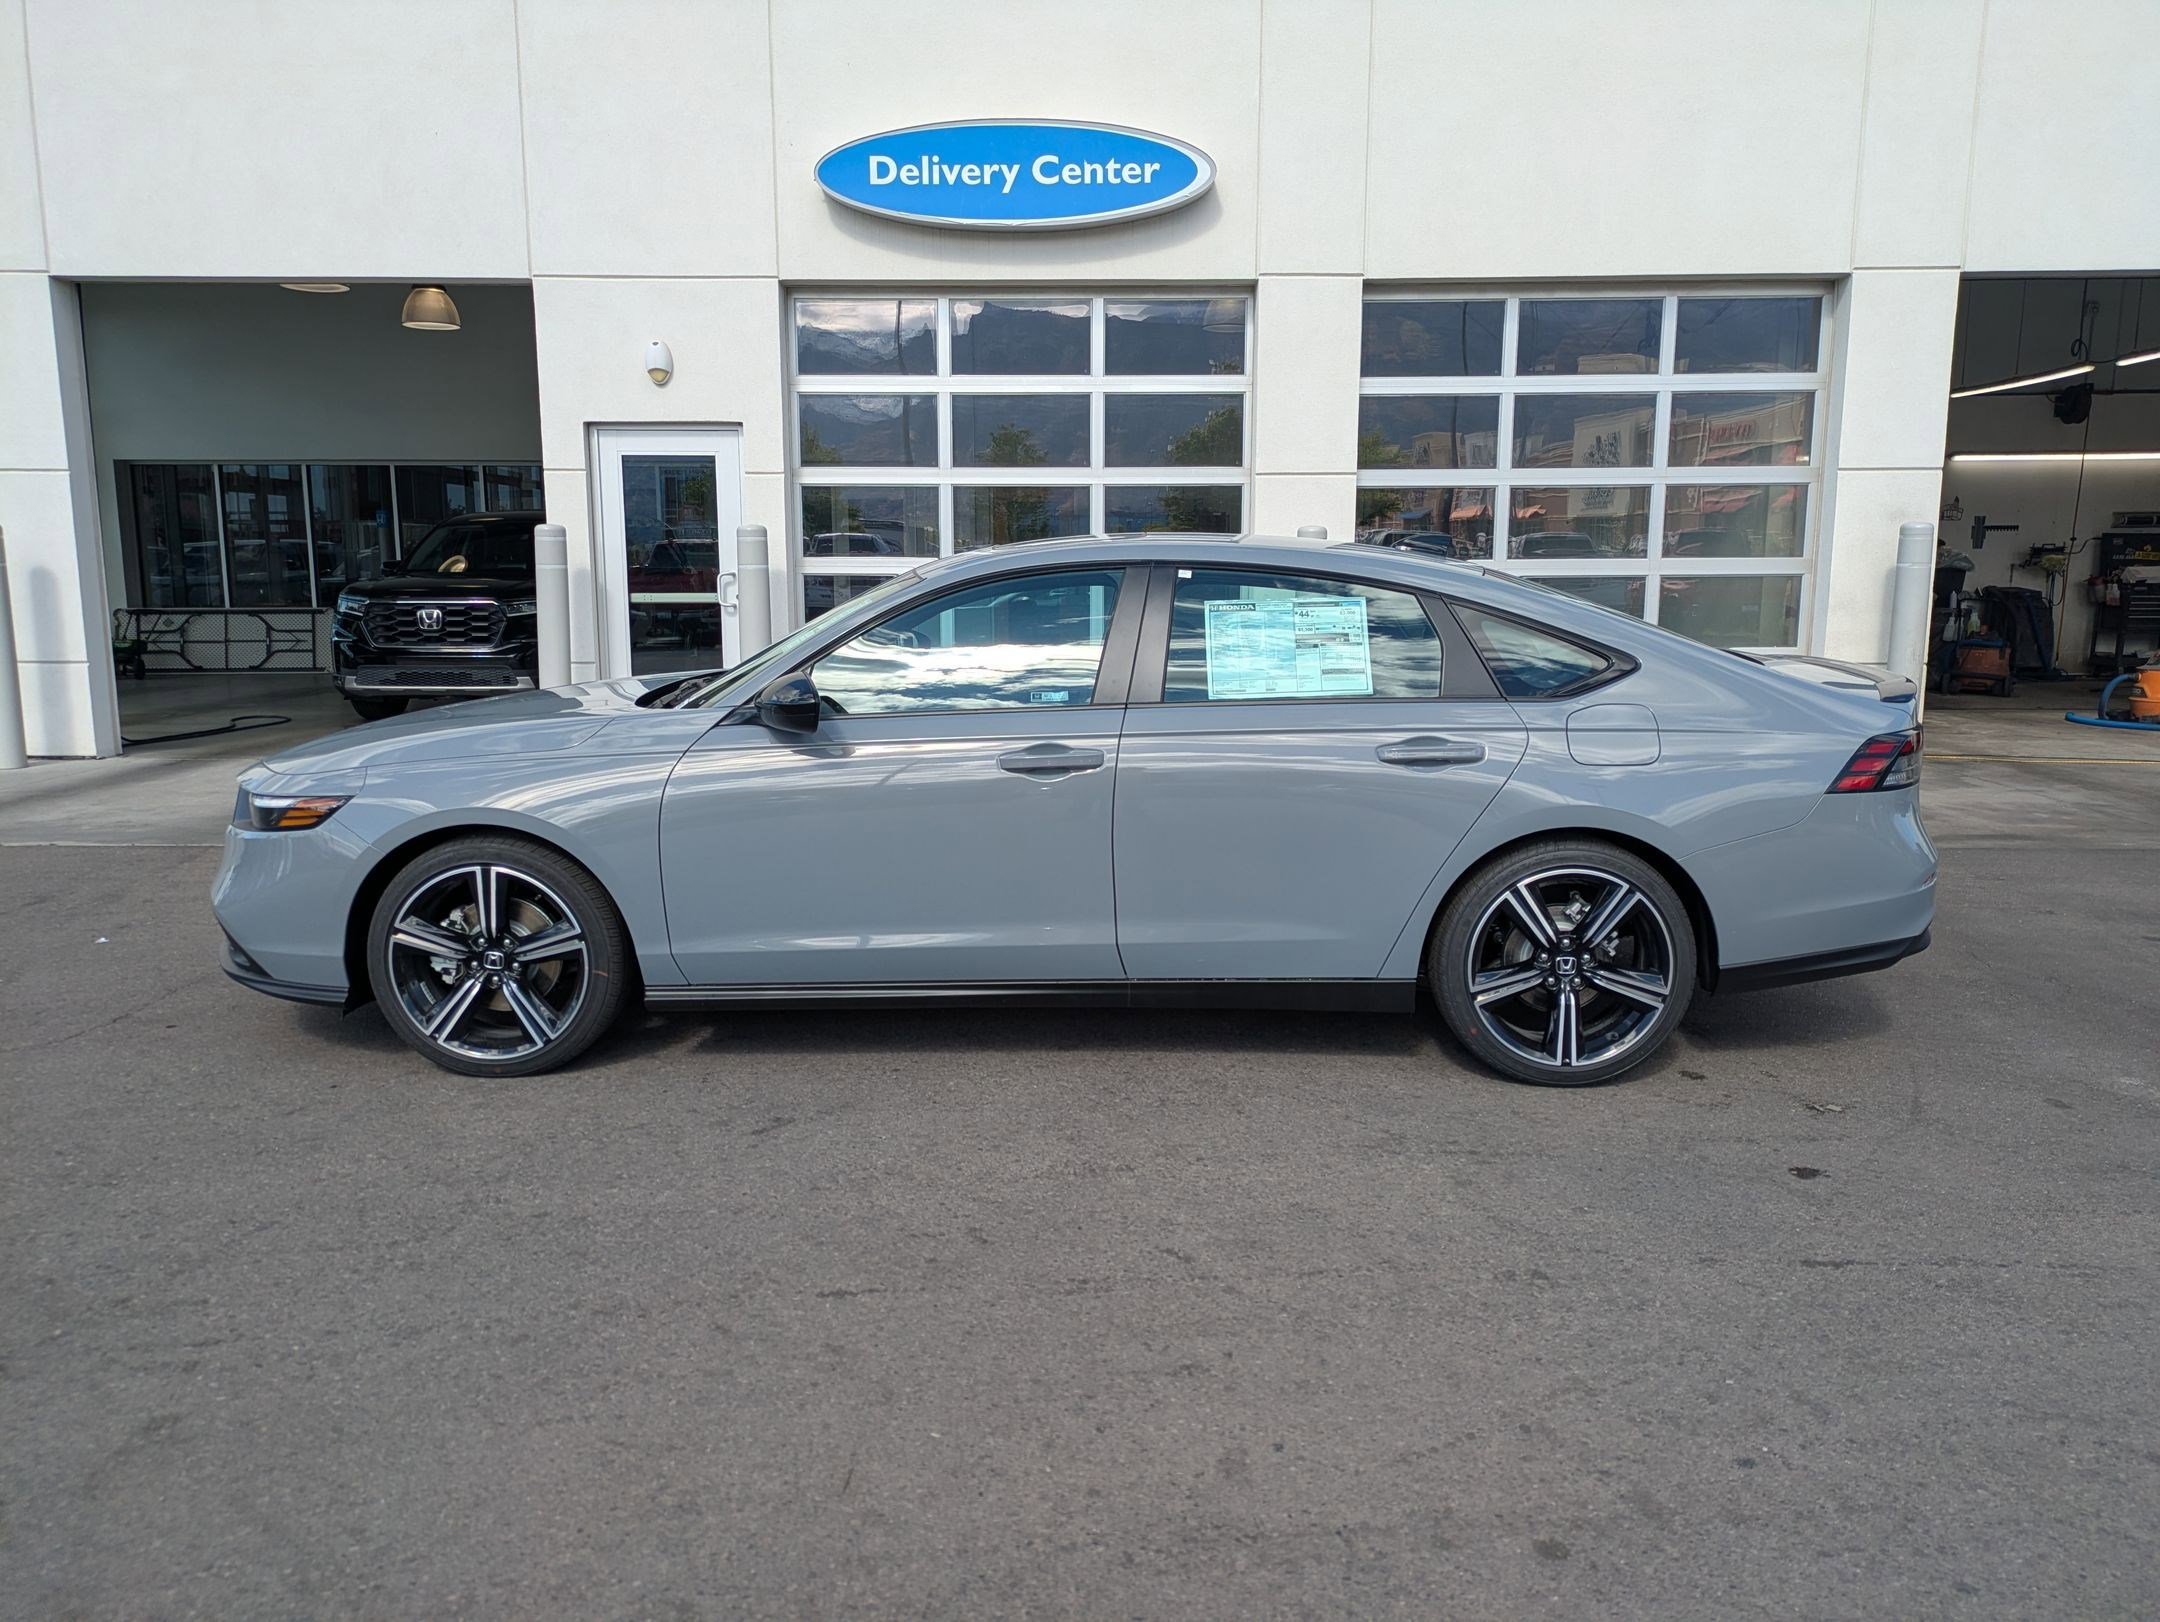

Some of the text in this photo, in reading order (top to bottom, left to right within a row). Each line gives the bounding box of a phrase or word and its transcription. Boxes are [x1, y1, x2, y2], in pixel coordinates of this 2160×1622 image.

[869, 154, 1161, 194] Delivery Center
[1298, 610, 1310, 618] 44
